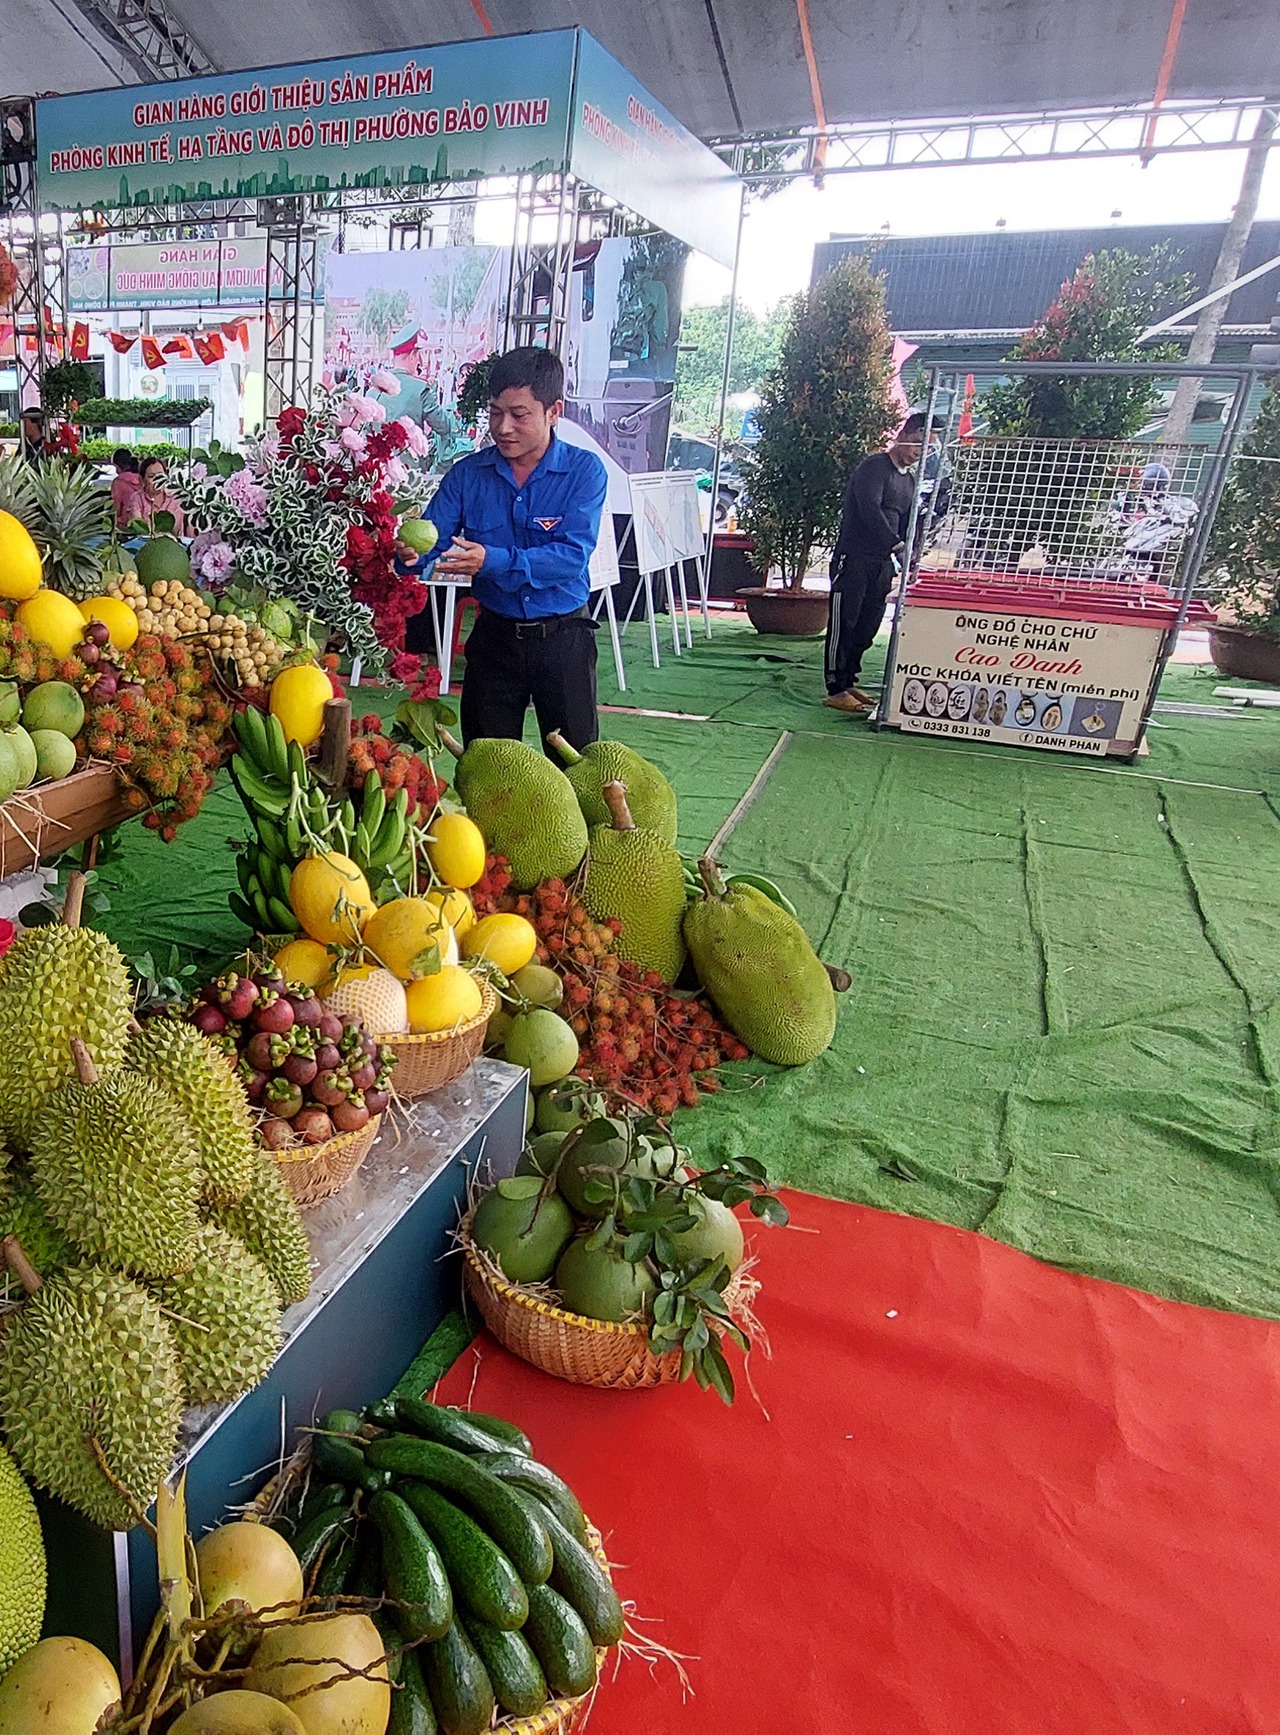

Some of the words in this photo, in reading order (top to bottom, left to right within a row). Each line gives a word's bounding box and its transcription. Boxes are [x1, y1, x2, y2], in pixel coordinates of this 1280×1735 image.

[134, 103, 172, 126] GIAN
[179, 93, 224, 120] HÀNG
[230, 84, 266, 115] GIỚI
[272, 78, 324, 110] THIỆU
[330, 71, 368, 103] SẢN
[374, 62, 432, 97] PHẨM
[582, 102, 611, 145] PHÒNG
[628, 95, 644, 128] GIAN
[51, 144, 102, 172] PHÒNG
[108, 145, 144, 166] KINH
[150, 133, 173, 164] TẾ,
[179, 136, 202, 161] HẠ
[207, 128, 252, 156] TẦNG
[258, 122, 282, 150] VÀ
[288, 119, 313, 148] ĐÔ
[319, 121, 349, 149] THỊ
[355, 108, 437, 141] PHƯỜNG
[444, 101, 487, 134] BẢO
[494, 99, 548, 128] VINH
[955, 615, 988, 630] ÔNG
[1021, 621, 1057, 636] CHO
[1061, 624, 1099, 640] CHỮ
[975, 633, 1019, 649] NGHỆ
[1024, 637, 1070, 652] NHÂN
[955, 646, 1000, 666] Cao
[1010, 652, 1082, 676] Danh
[896, 662, 931, 677] MÓC
[936, 667, 981, 683] KHÓA
[986, 671, 1024, 687] VIẾT
[1026, 676, 1058, 691] TÊN
[923, 721, 949, 734] 0333
[951, 725, 971, 736] 831
[973, 727, 991, 738] 138
[1035, 735, 1067, 748] DANH
[1070, 739, 1100, 751] PHAN
